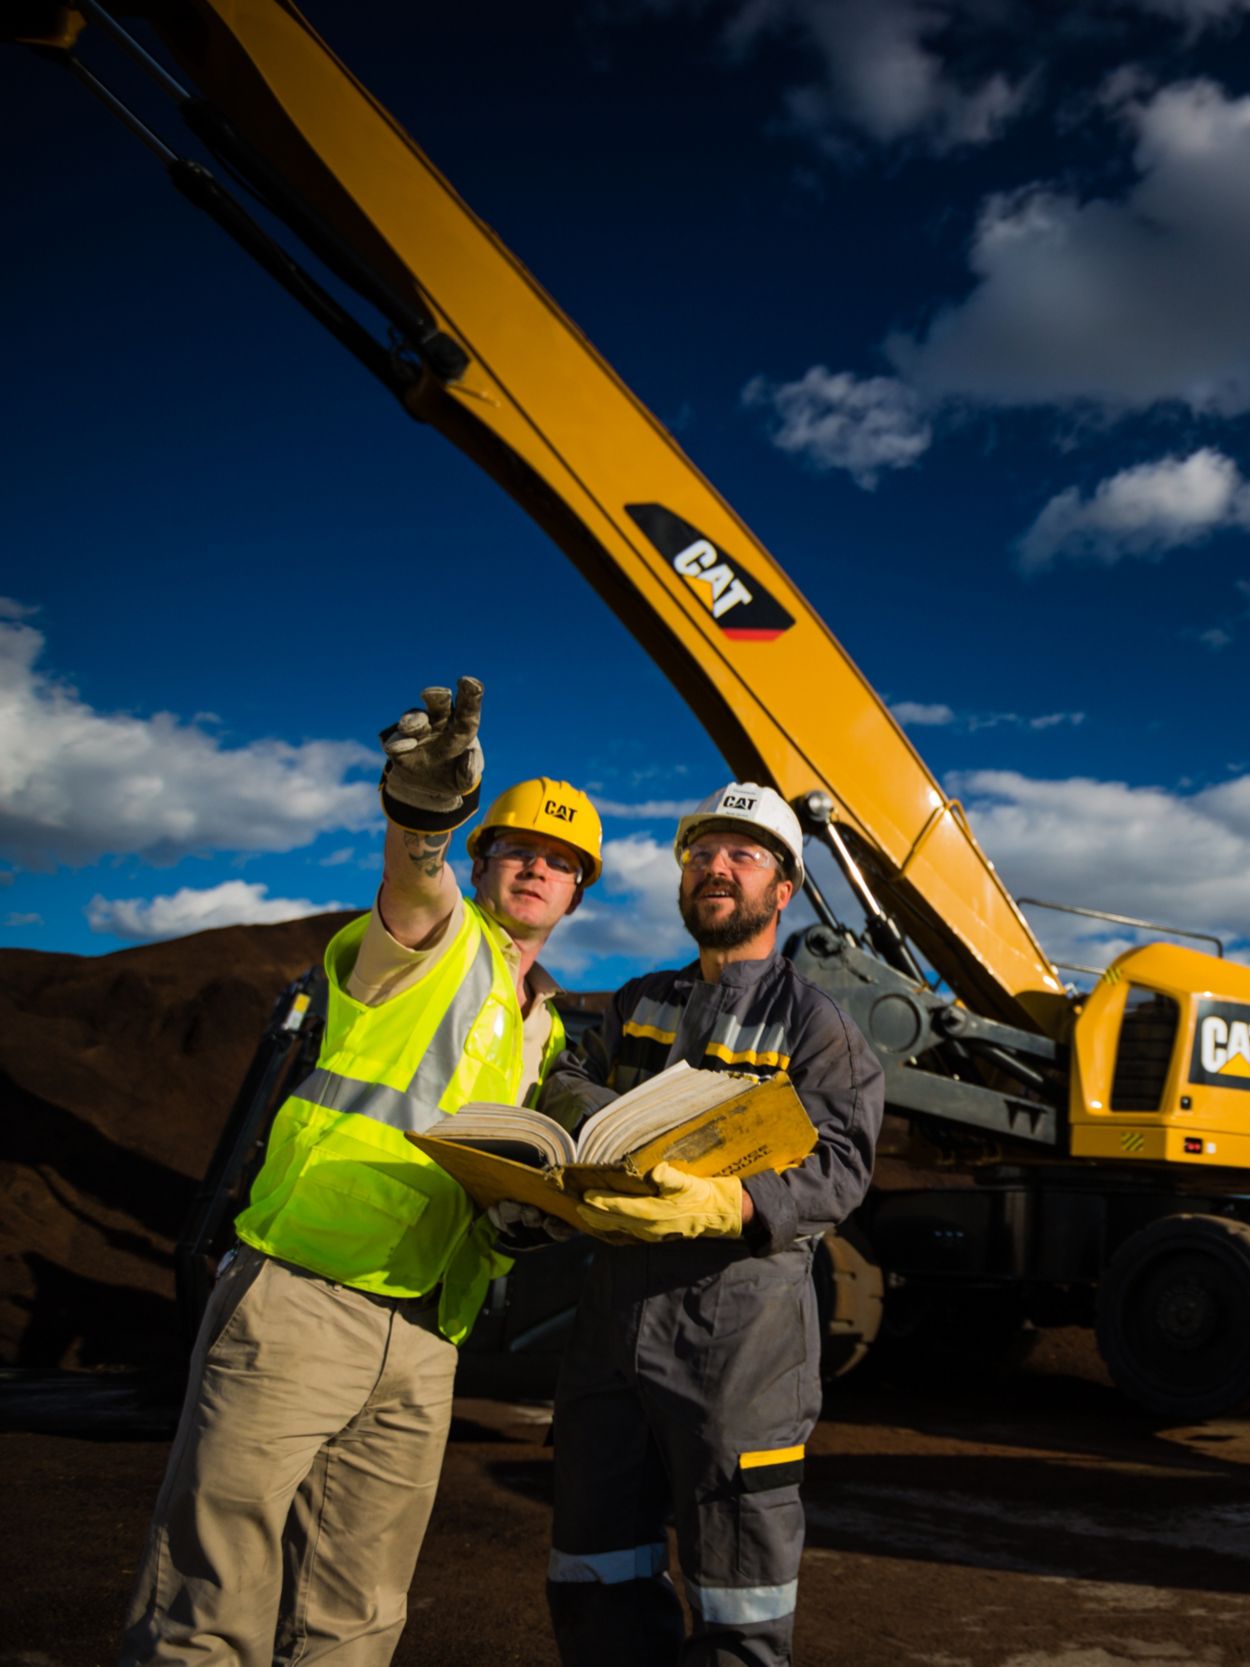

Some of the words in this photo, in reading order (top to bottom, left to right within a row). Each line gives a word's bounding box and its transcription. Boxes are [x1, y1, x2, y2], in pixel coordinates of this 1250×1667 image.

[673, 538, 753, 619] CAT
[544, 800, 578, 823] CAT
[723, 795, 757, 811] CAT
